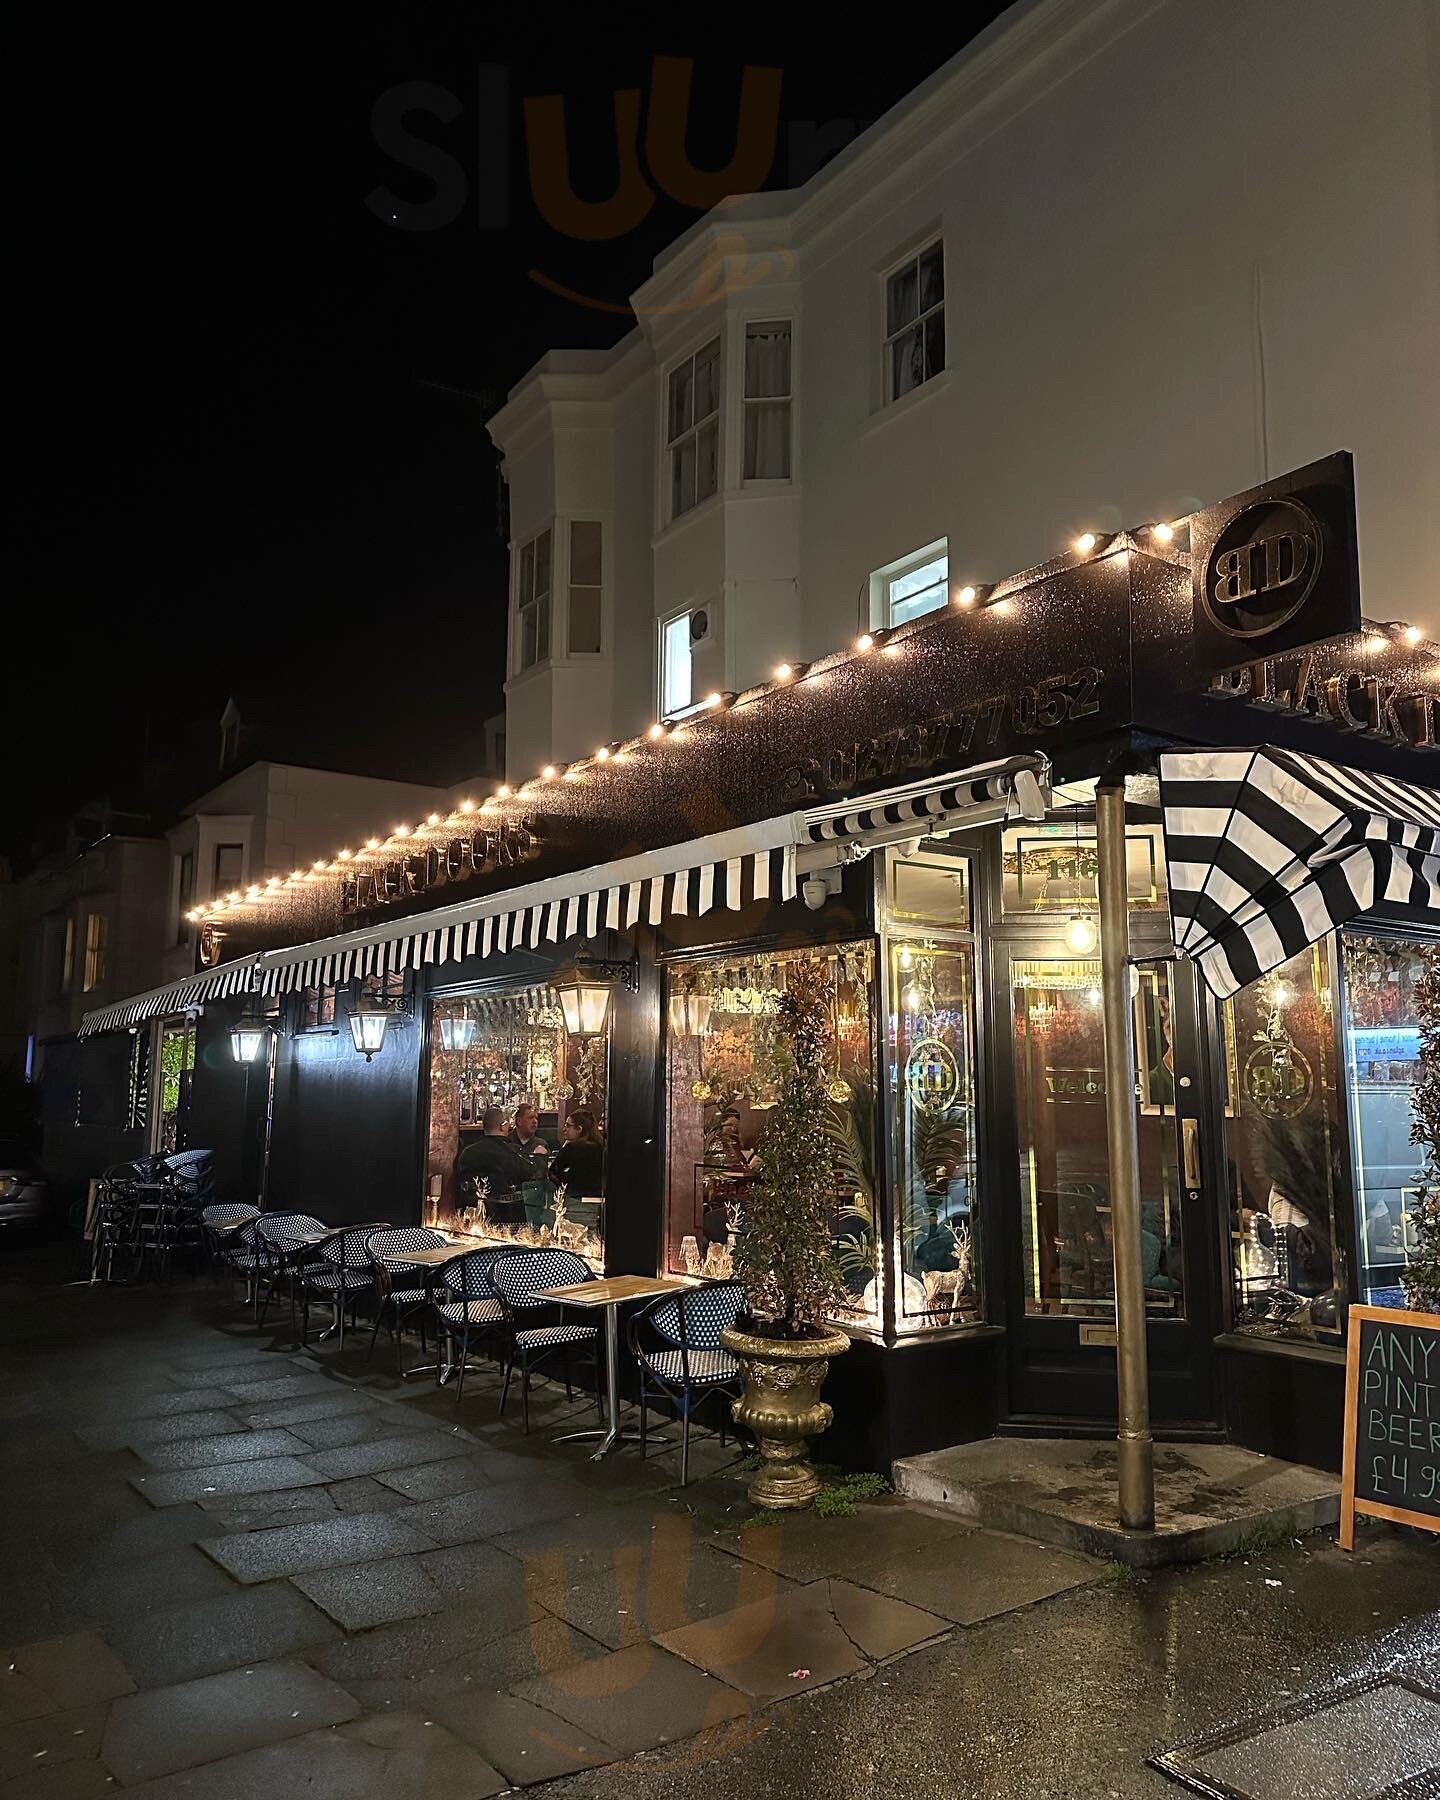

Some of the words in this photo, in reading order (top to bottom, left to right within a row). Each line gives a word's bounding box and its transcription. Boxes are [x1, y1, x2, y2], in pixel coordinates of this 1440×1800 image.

[1366, 1328, 1437, 1378] ANY
[1363, 1368, 1439, 1417] PINT
[1368, 1408, 1440, 1454] BEER
